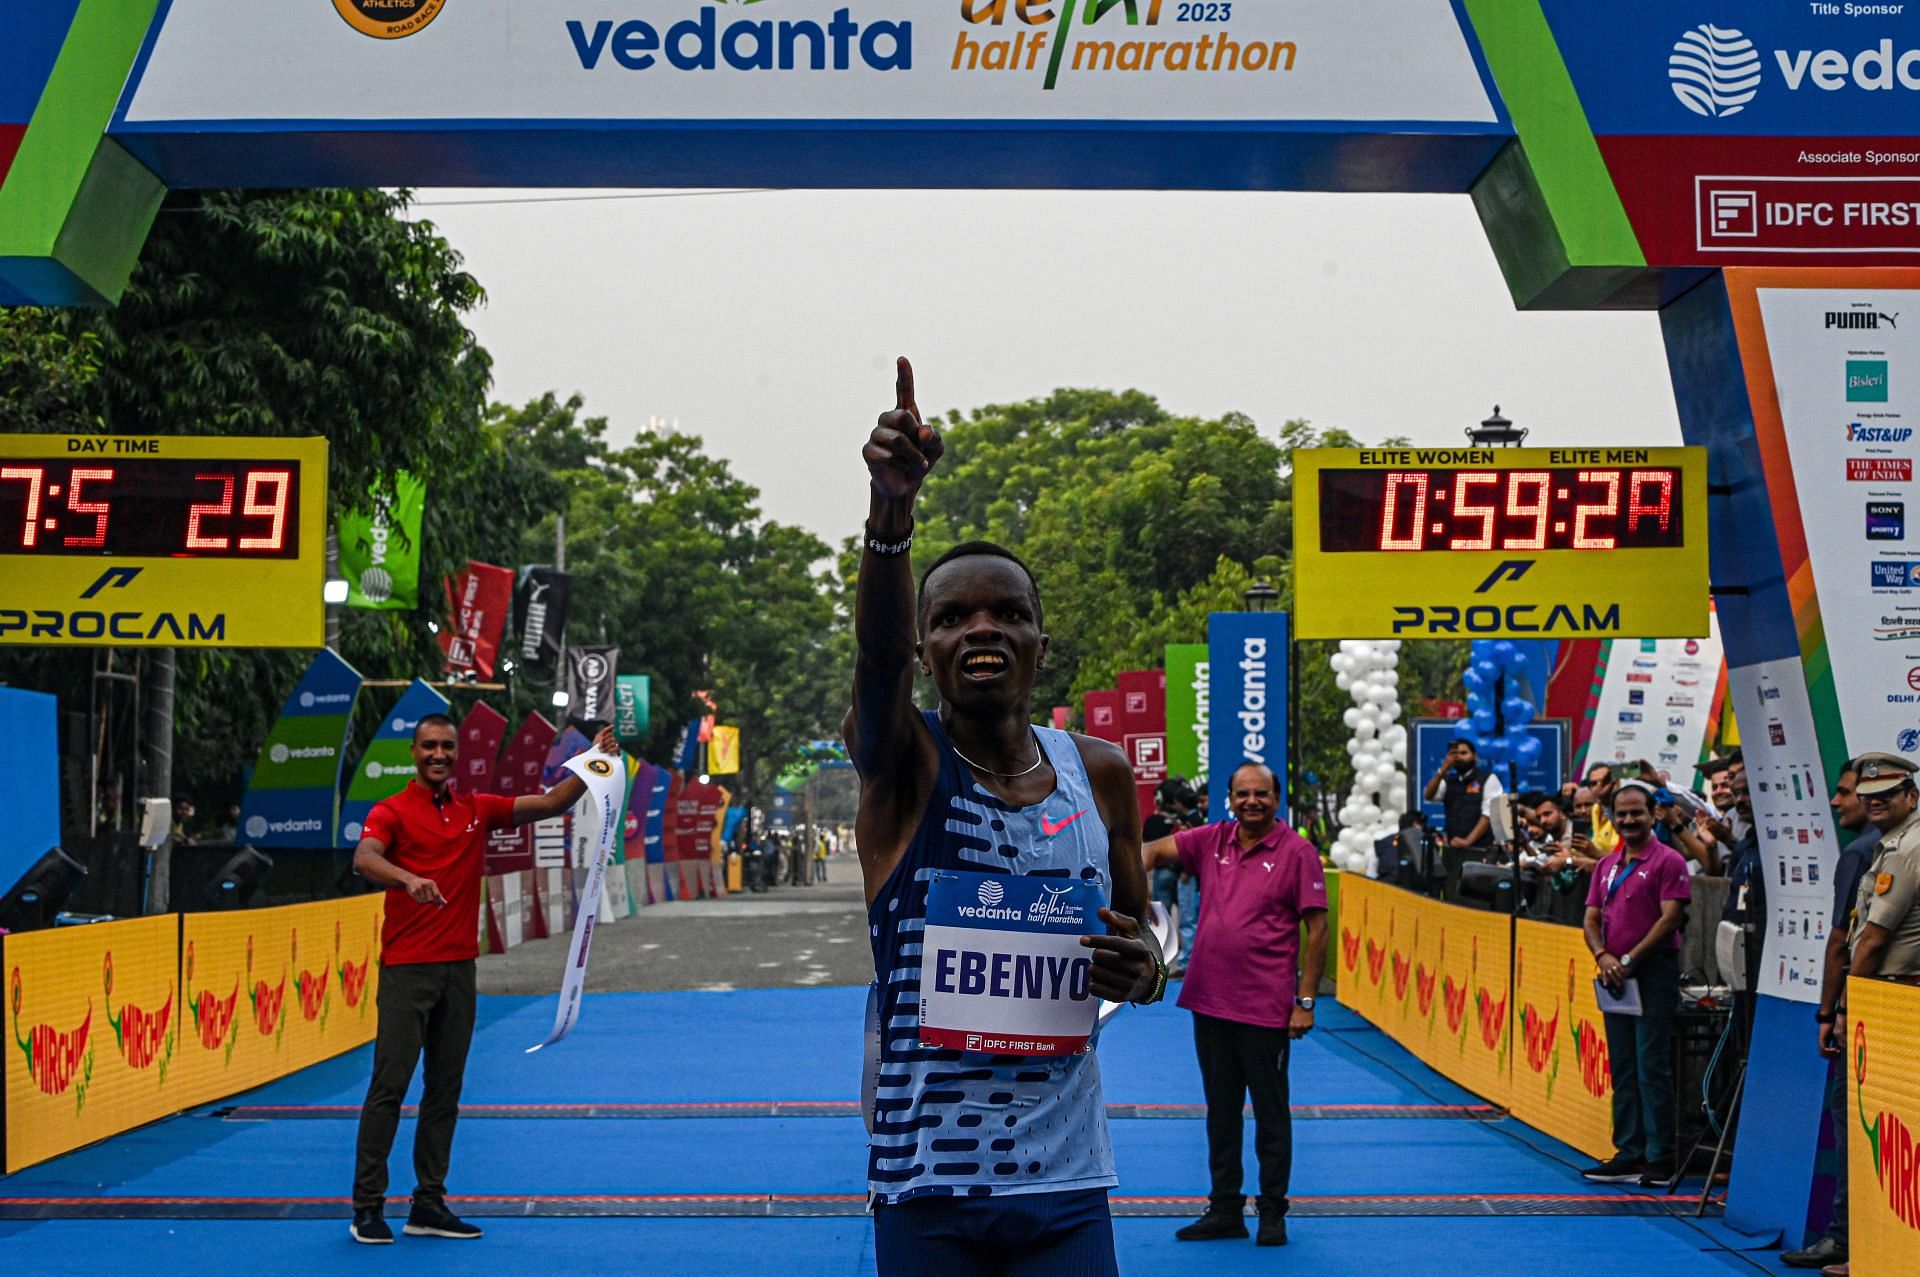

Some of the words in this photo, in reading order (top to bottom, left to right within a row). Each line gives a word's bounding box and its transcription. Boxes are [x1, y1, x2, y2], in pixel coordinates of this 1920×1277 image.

[1176, 3, 1231, 22] 2023
[1811, 2, 1840, 15] Title
[1844, 2, 1904, 17] Sponsor
[566, 8, 912, 71] vedanta
[951, 31, 1048, 70] half
[1071, 32, 1298, 71] marathon
[1798, 151, 1861, 164] Associate
[1865, 151, 1920, 165] Sponsor
[1765, 202, 1834, 226] IDFC
[1825, 311, 1878, 329] PUMA
[1849, 374, 1883, 388] Bisleri
[1850, 422, 1912, 442] FAST&UP
[67, 438, 108, 452] DAY
[113, 439, 159, 453] TIME
[1360, 451, 1411, 465] ELITE
[1416, 450, 1494, 464] WOMEN
[1549, 450, 1602, 464] ELITE
[1606, 450, 1648, 463] MEN
[1849, 460, 1872, 470] THE
[1875, 460, 1911, 470] TIMES
[1854, 470, 1870, 479] OF
[1872, 470, 1904, 480] INDIA
[1874, 564, 1904, 575] United
[1885, 574, 1904, 585] Way
[0, 610, 225, 640] PROCAM
[1393, 604, 1620, 633] PROCAM
[522, 603, 548, 660] PUMA
[584, 686, 598, 721] TATA
[1887, 695, 1914, 703] DELHI
[290, 746, 335, 758] vedanta
[269, 819, 321, 833] vedanta
[957, 904, 1022, 920] vedanta
[1030, 893, 1066, 926] delhi
[1027, 913, 1044, 922] half
[1047, 915, 1083, 924] marathon
[934, 949, 1092, 1002] EBENYO
[983, 1039, 1007, 1049] IDFC
[1009, 1041, 1035, 1051] FIRST
[1036, 1042, 1056, 1051] Bank
